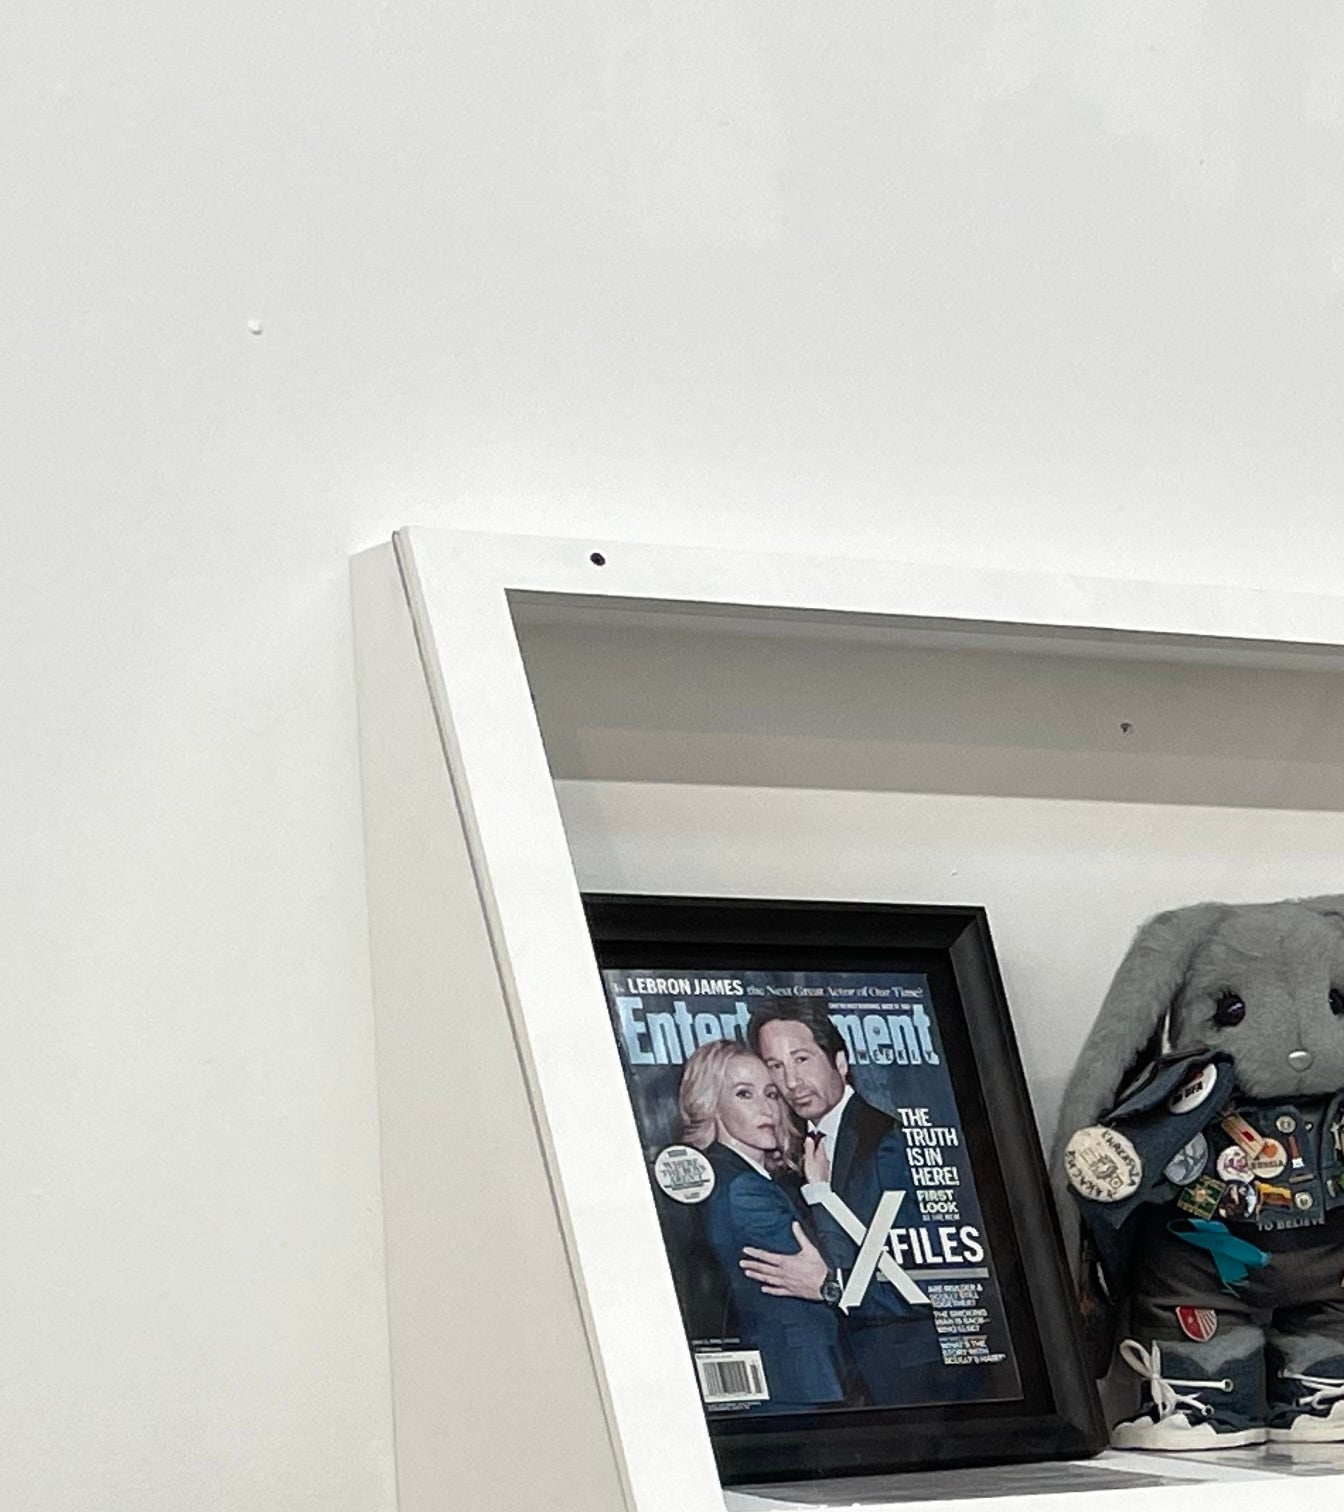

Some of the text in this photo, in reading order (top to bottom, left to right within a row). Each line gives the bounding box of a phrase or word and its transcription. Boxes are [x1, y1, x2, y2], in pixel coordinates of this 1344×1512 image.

[627, 978, 691, 995] LEBRON
[694, 979, 744, 995] JAMES
[766, 985, 792, 996] Next
[793, 985, 824, 996] Great
[897, 1108, 932, 1126] THE
[902, 1127, 958, 1146] TRUTH
[906, 1147, 943, 1166] IS IN
[911, 1166, 960, 1186] HERE!
[916, 1190, 953, 1201] FIRST
[920, 1201, 958, 1213] LOOK
